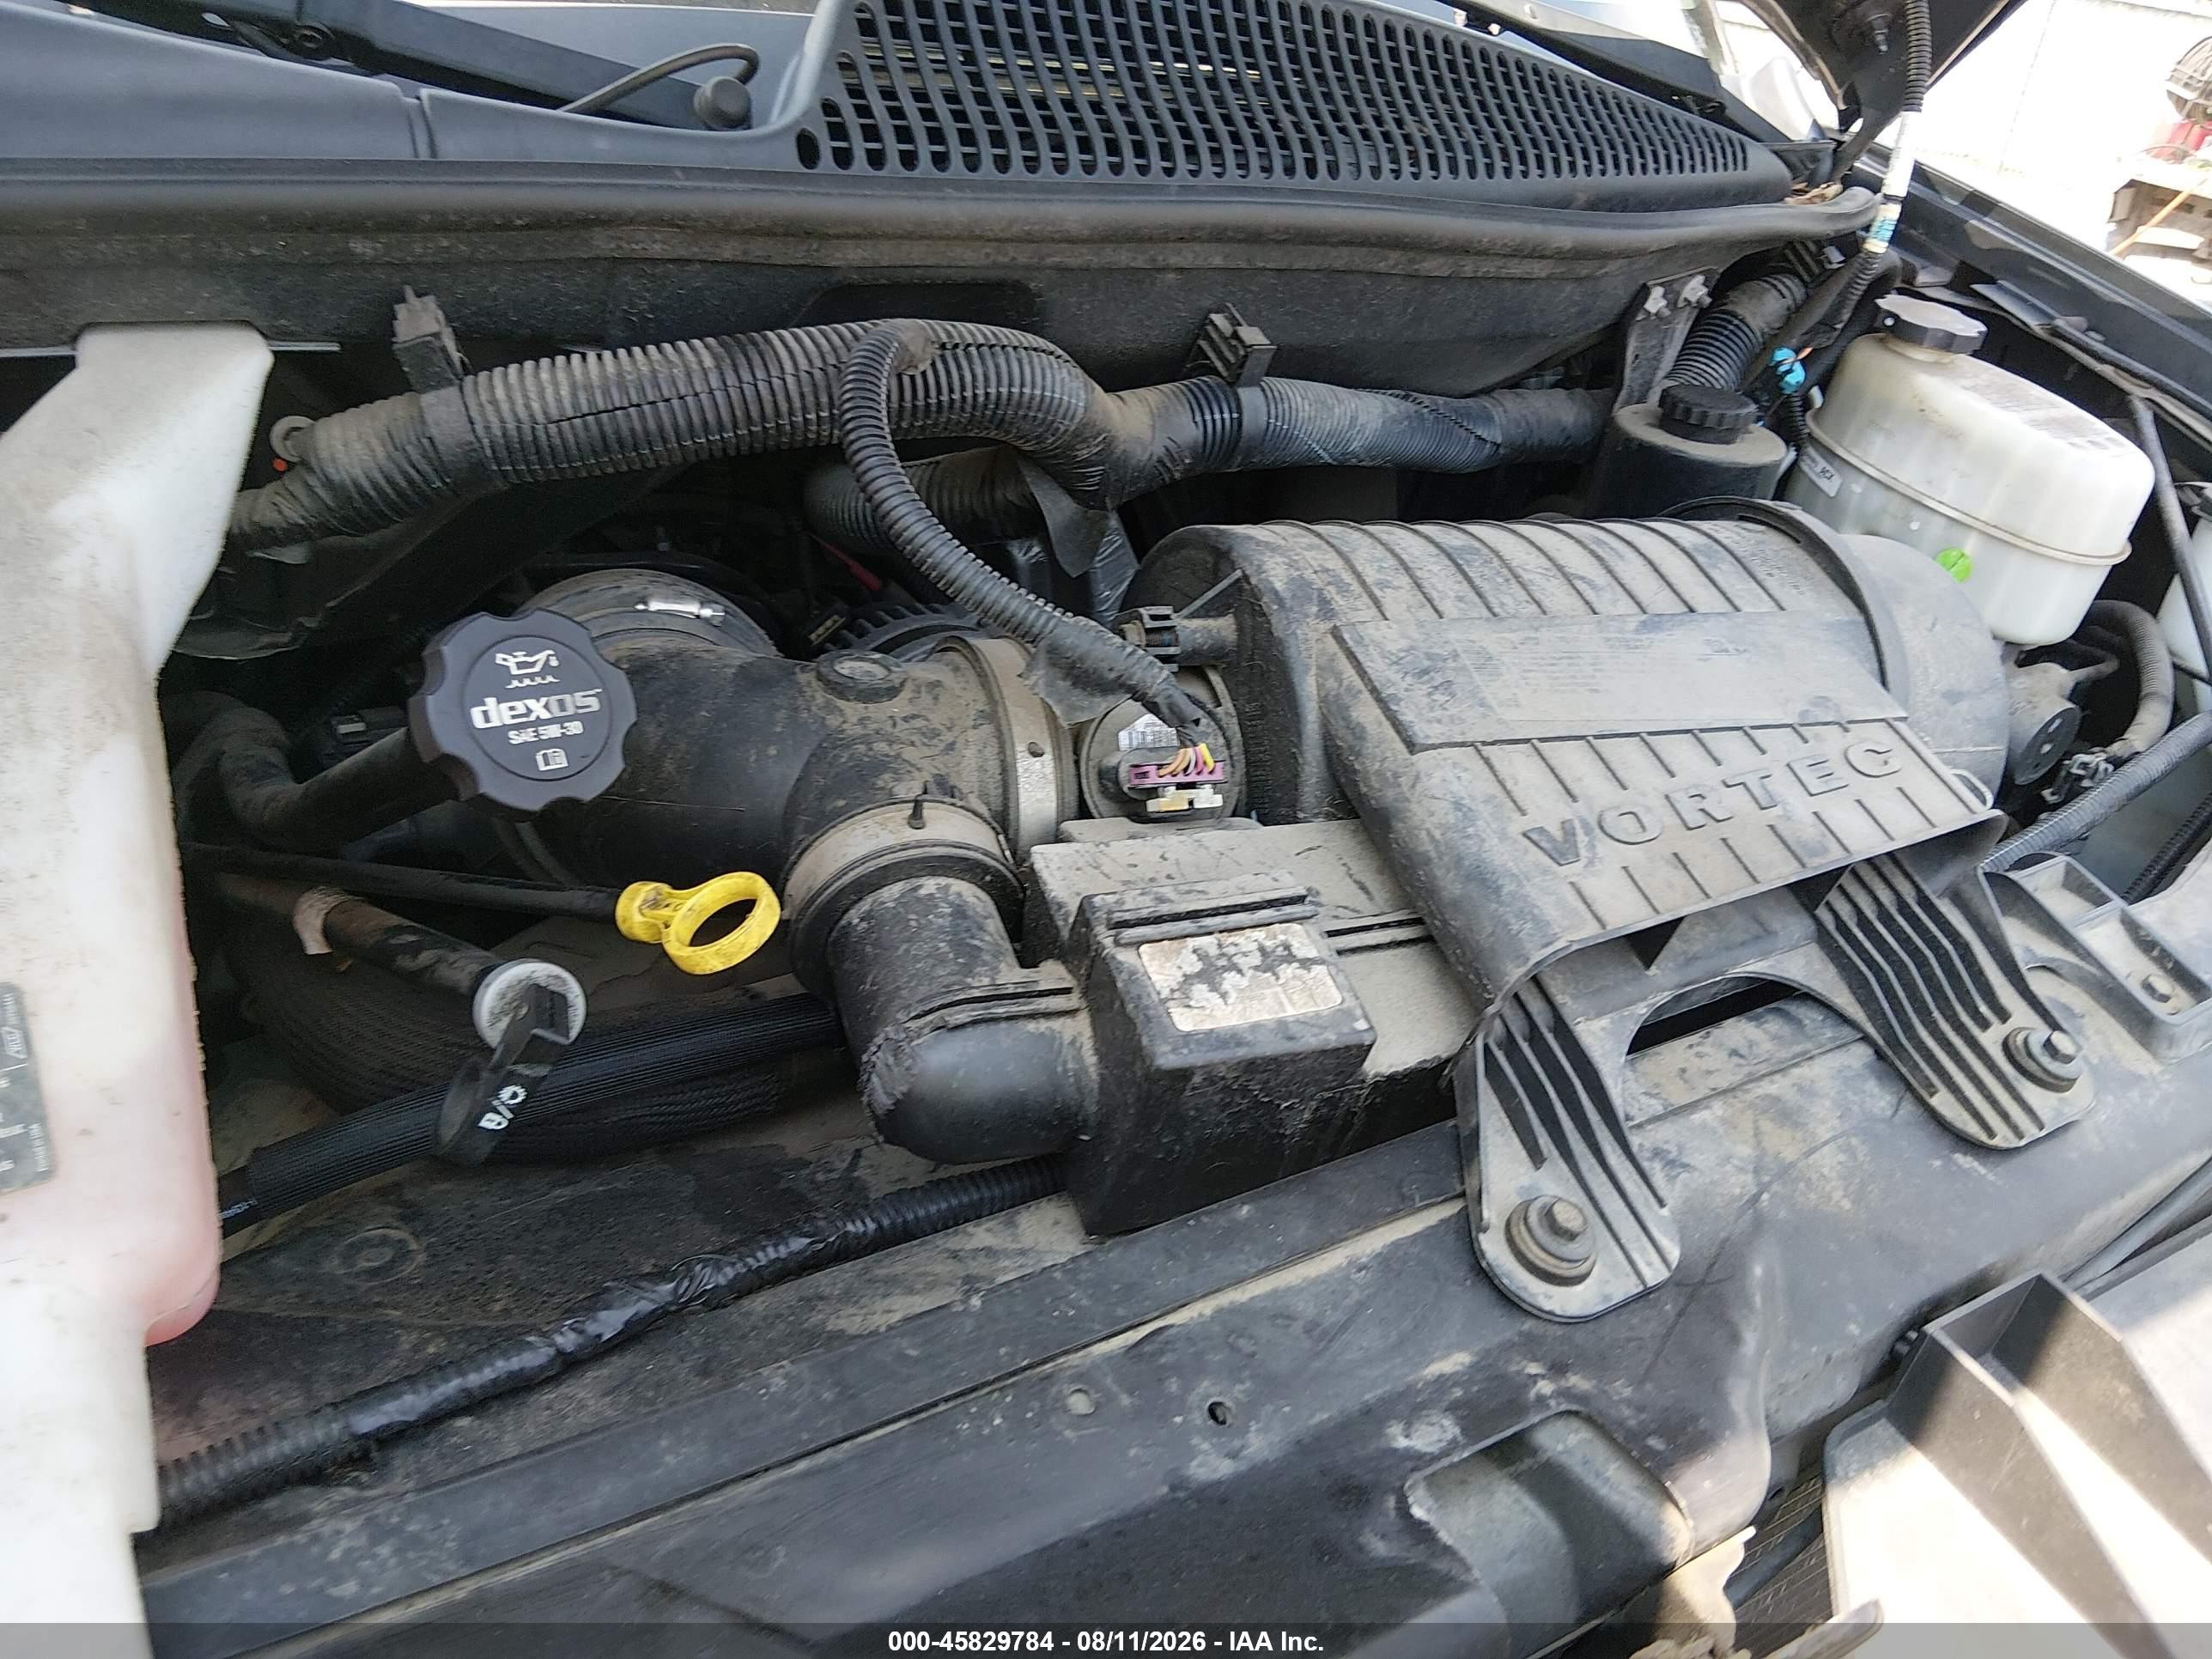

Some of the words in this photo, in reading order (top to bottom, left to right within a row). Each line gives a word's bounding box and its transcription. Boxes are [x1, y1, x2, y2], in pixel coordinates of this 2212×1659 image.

[470, 688, 602, 729] dexos
[507, 727, 539, 745] SAE
[1522, 742, 1901, 866] VORTEC
